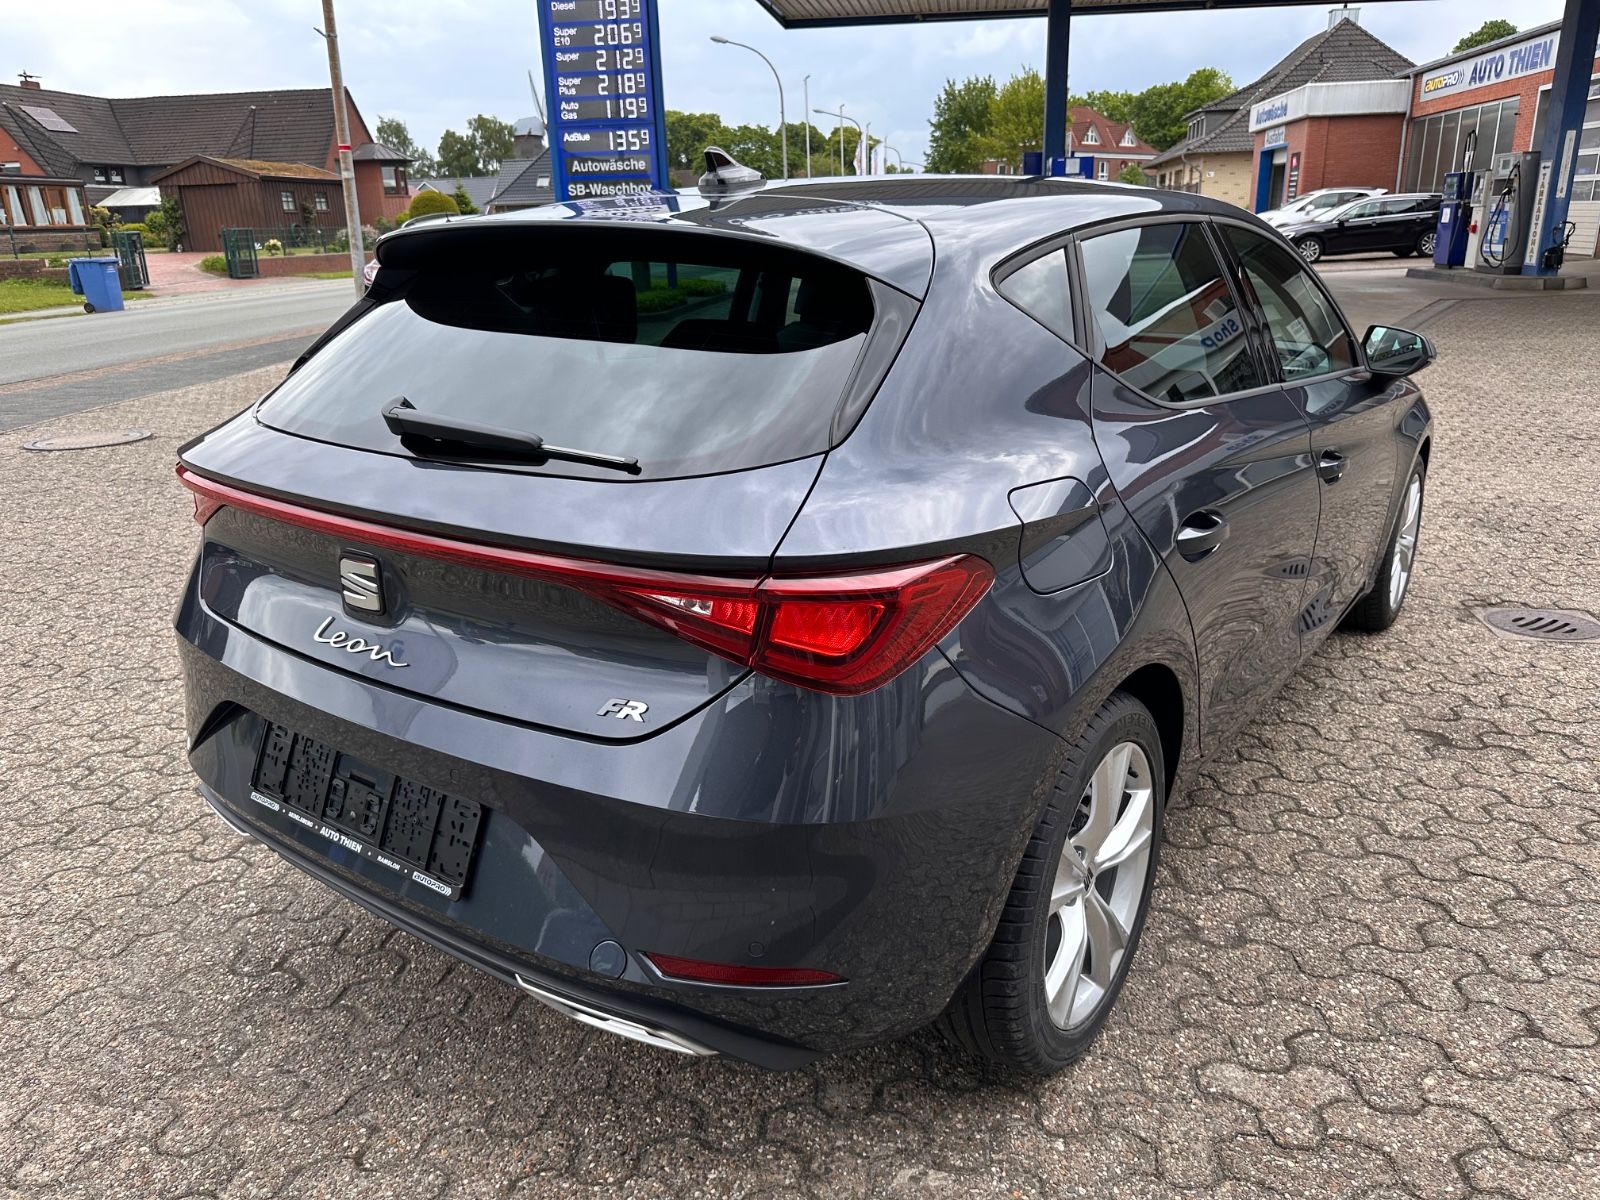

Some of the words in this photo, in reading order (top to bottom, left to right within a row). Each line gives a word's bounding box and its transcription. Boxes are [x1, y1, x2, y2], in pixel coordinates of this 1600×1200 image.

[551, 2, 576, 11] Diesel
[553, 27, 577, 37] Super
[594, 23, 642, 46] 2069
[554, 37, 571, 46] E10
[555, 52, 579, 62] Super
[596, 48, 644, 71] 2129
[1468, 54, 1504, 87] AUTO
[1508, 39, 1554, 75] THIEN
[558, 77, 581, 86] Super
[598, 73, 645, 95] 2189
[559, 87, 576, 96] Plus
[560, 101, 579, 110] Auto
[606, 97, 648, 119] 1199
[560, 111, 578, 120] Gas
[563, 132, 591, 142] AdBlue
[608, 129, 650, 151] 1359
[571, 158, 646, 173] Autowäsche
[313, 616, 410, 668] Leon
[597, 699, 649, 723] FR
[320, 826, 340, 841] AUTO
[340, 835, 362, 853] THIEN
